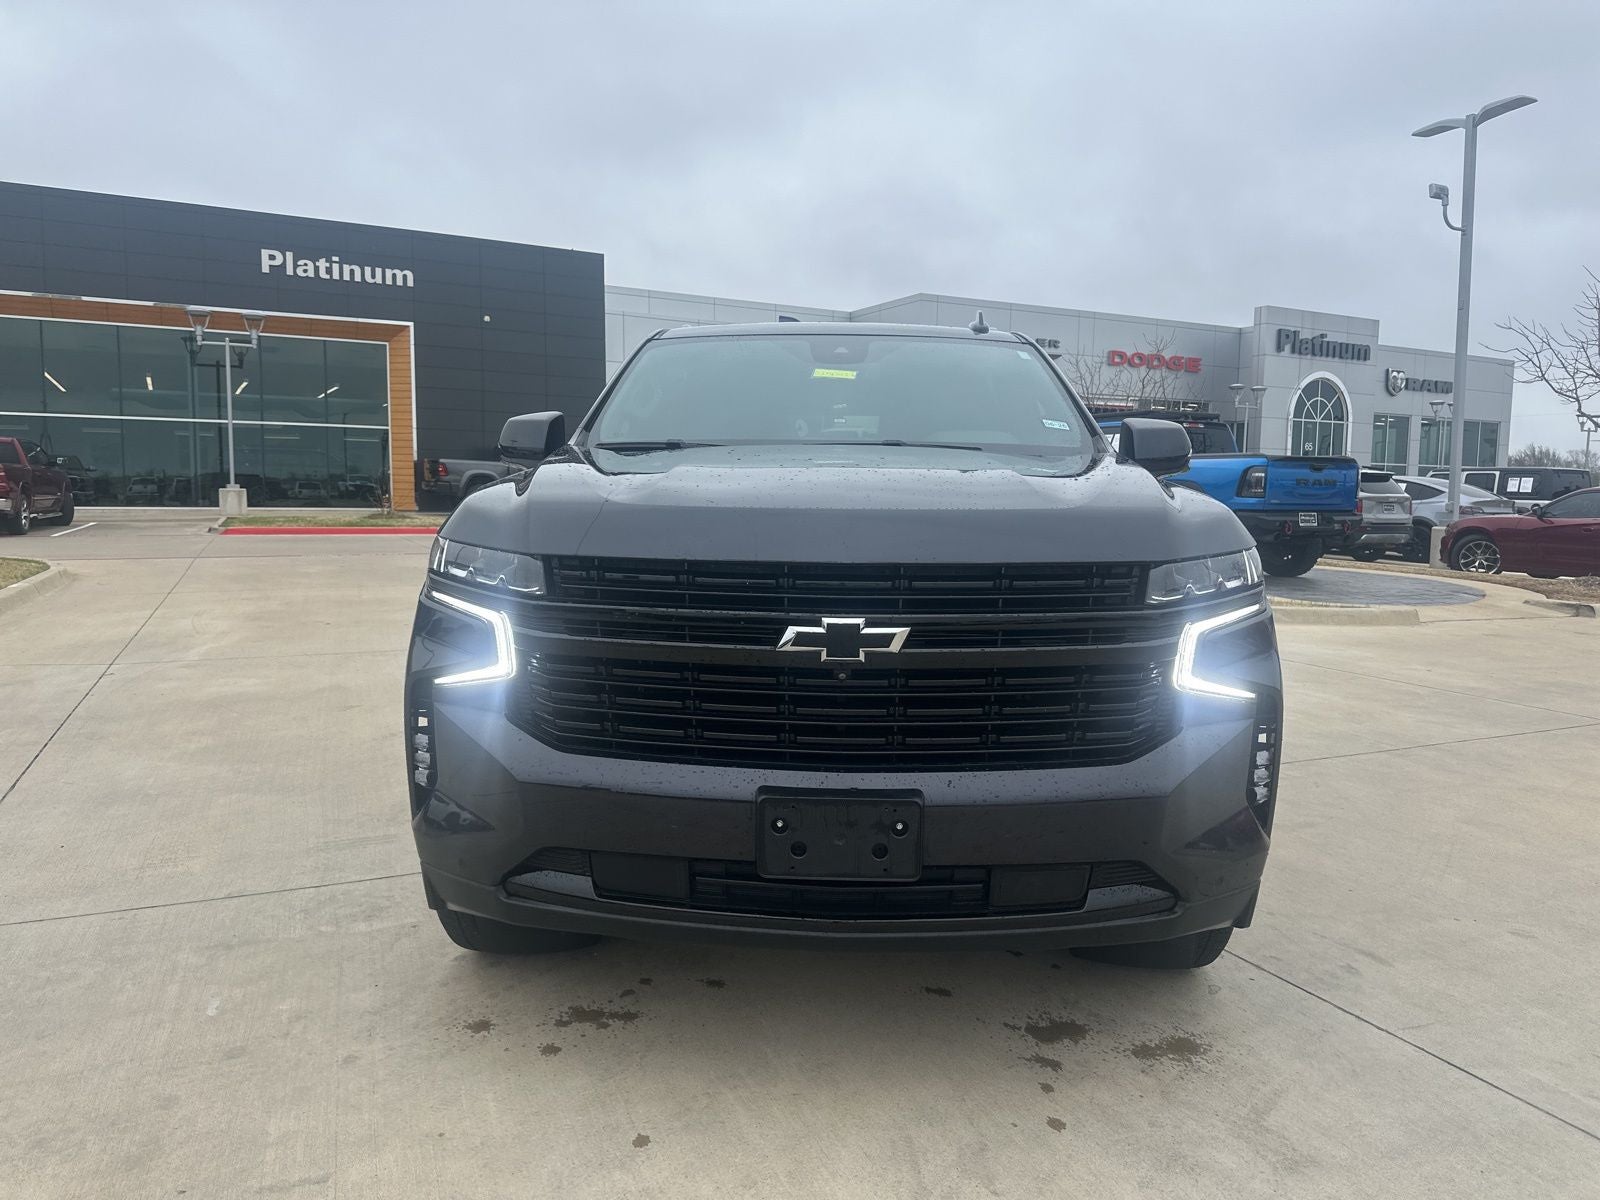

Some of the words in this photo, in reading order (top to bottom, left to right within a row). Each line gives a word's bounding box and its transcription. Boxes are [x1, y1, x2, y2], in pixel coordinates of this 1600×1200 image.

[260, 248, 415, 288] Platinum
[1276, 328, 1371, 361] Platinum
[1108, 350, 1203, 373] DODGE
[1405, 378, 1454, 394] RAM
[1304, 442, 1313, 451] 65
[1296, 478, 1338, 488] RAM
